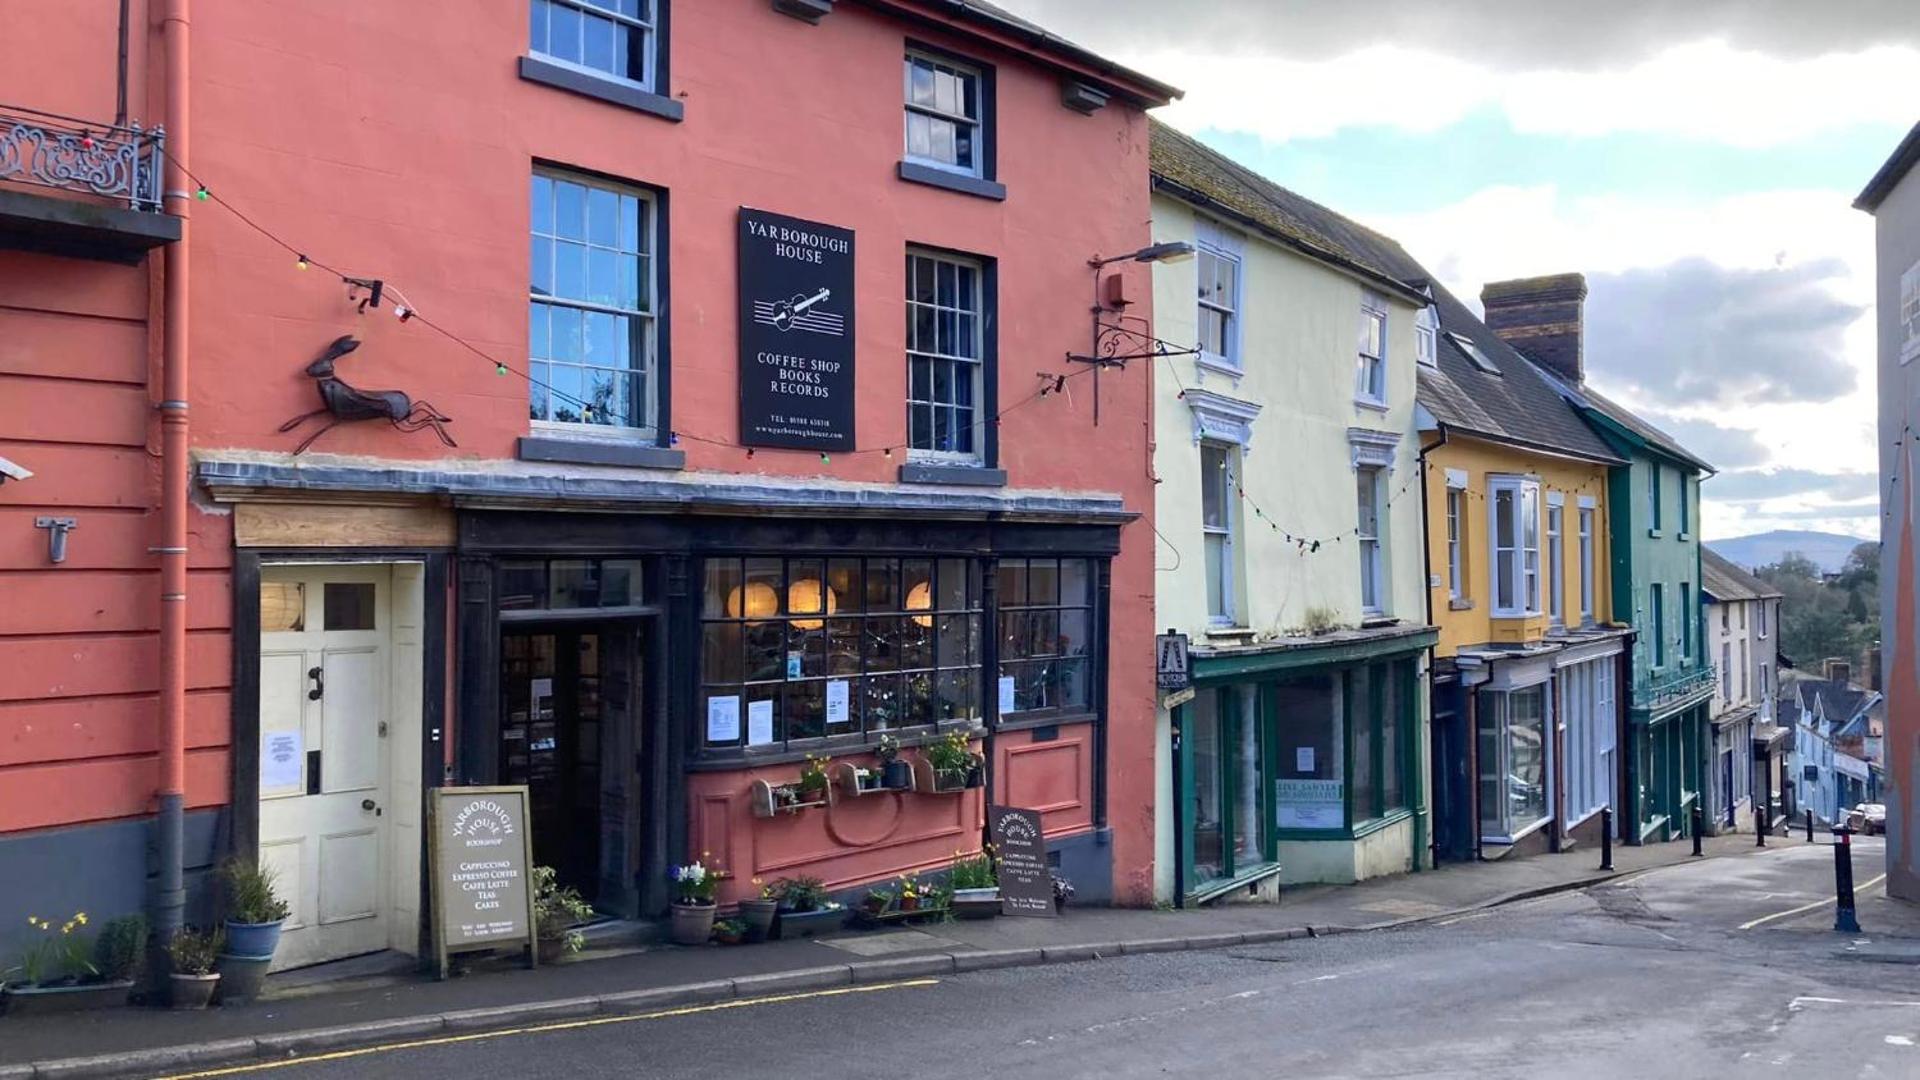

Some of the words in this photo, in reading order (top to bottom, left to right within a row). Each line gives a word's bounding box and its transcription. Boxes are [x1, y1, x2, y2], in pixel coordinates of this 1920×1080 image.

[747, 220, 849, 254] YARBOROUGH
[776, 242, 823, 264] HOUSE
[757, 352, 806, 369] COFFEE
[811, 359, 841, 373] SHOP
[779, 368, 821, 384] BOOKS
[771, 381, 829, 398] RECORDS
[453, 799, 514, 837] YARBOROUGH
[466, 818, 501, 836] HOUSE
[460, 860, 511, 871] CAPPUCCINO
[490, 869, 518, 879] COFFEE
[478, 891, 496, 900] TEAS
[474, 900, 500, 910] CAKES
